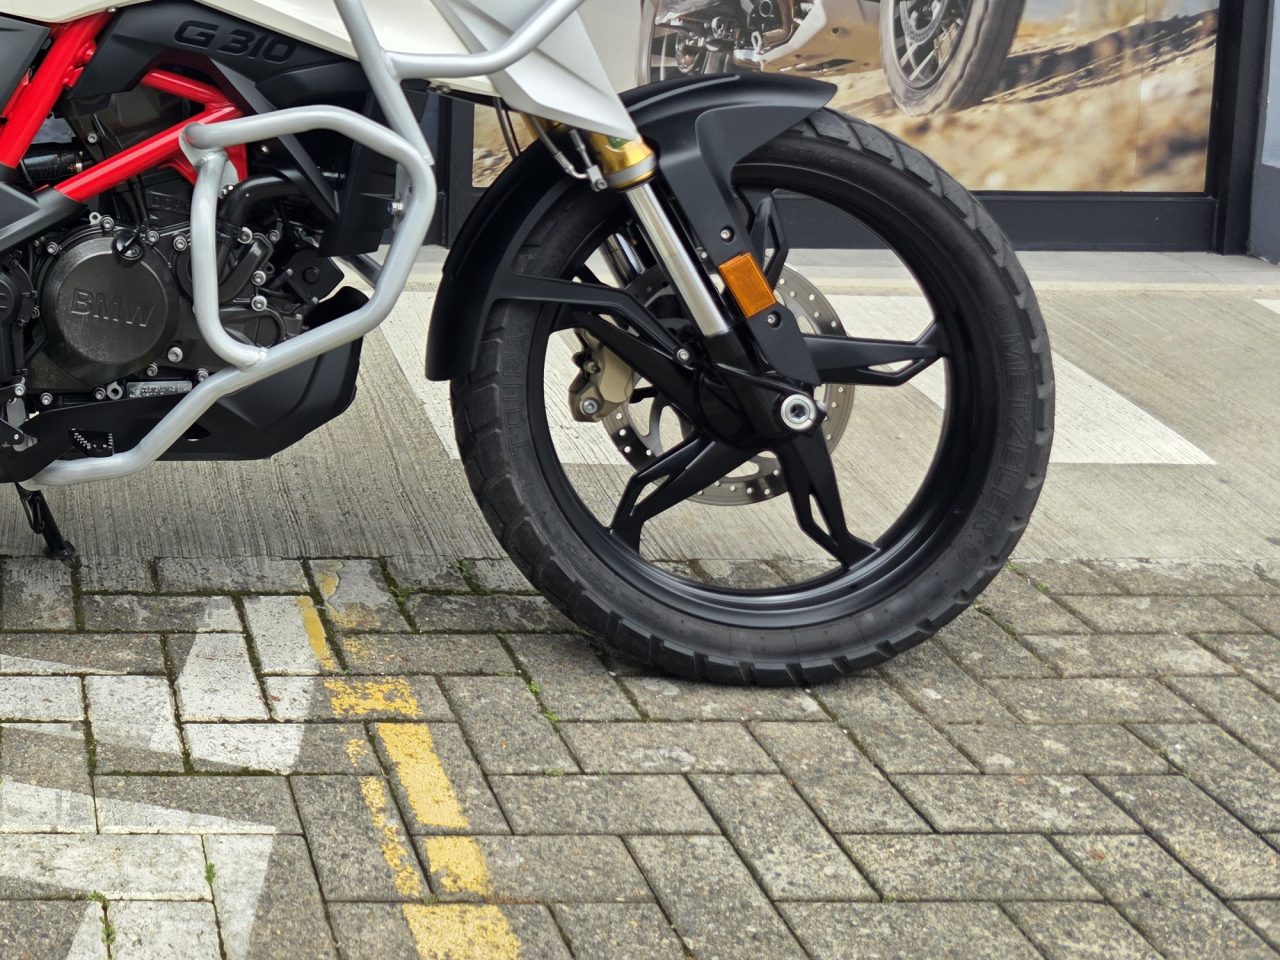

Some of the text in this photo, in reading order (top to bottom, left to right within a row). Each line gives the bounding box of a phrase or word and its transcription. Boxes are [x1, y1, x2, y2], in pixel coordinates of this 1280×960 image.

[173, 19, 297, 64] G 310
[70, 287, 156, 328] BMW
[971, 333, 1030, 538] METZELER
